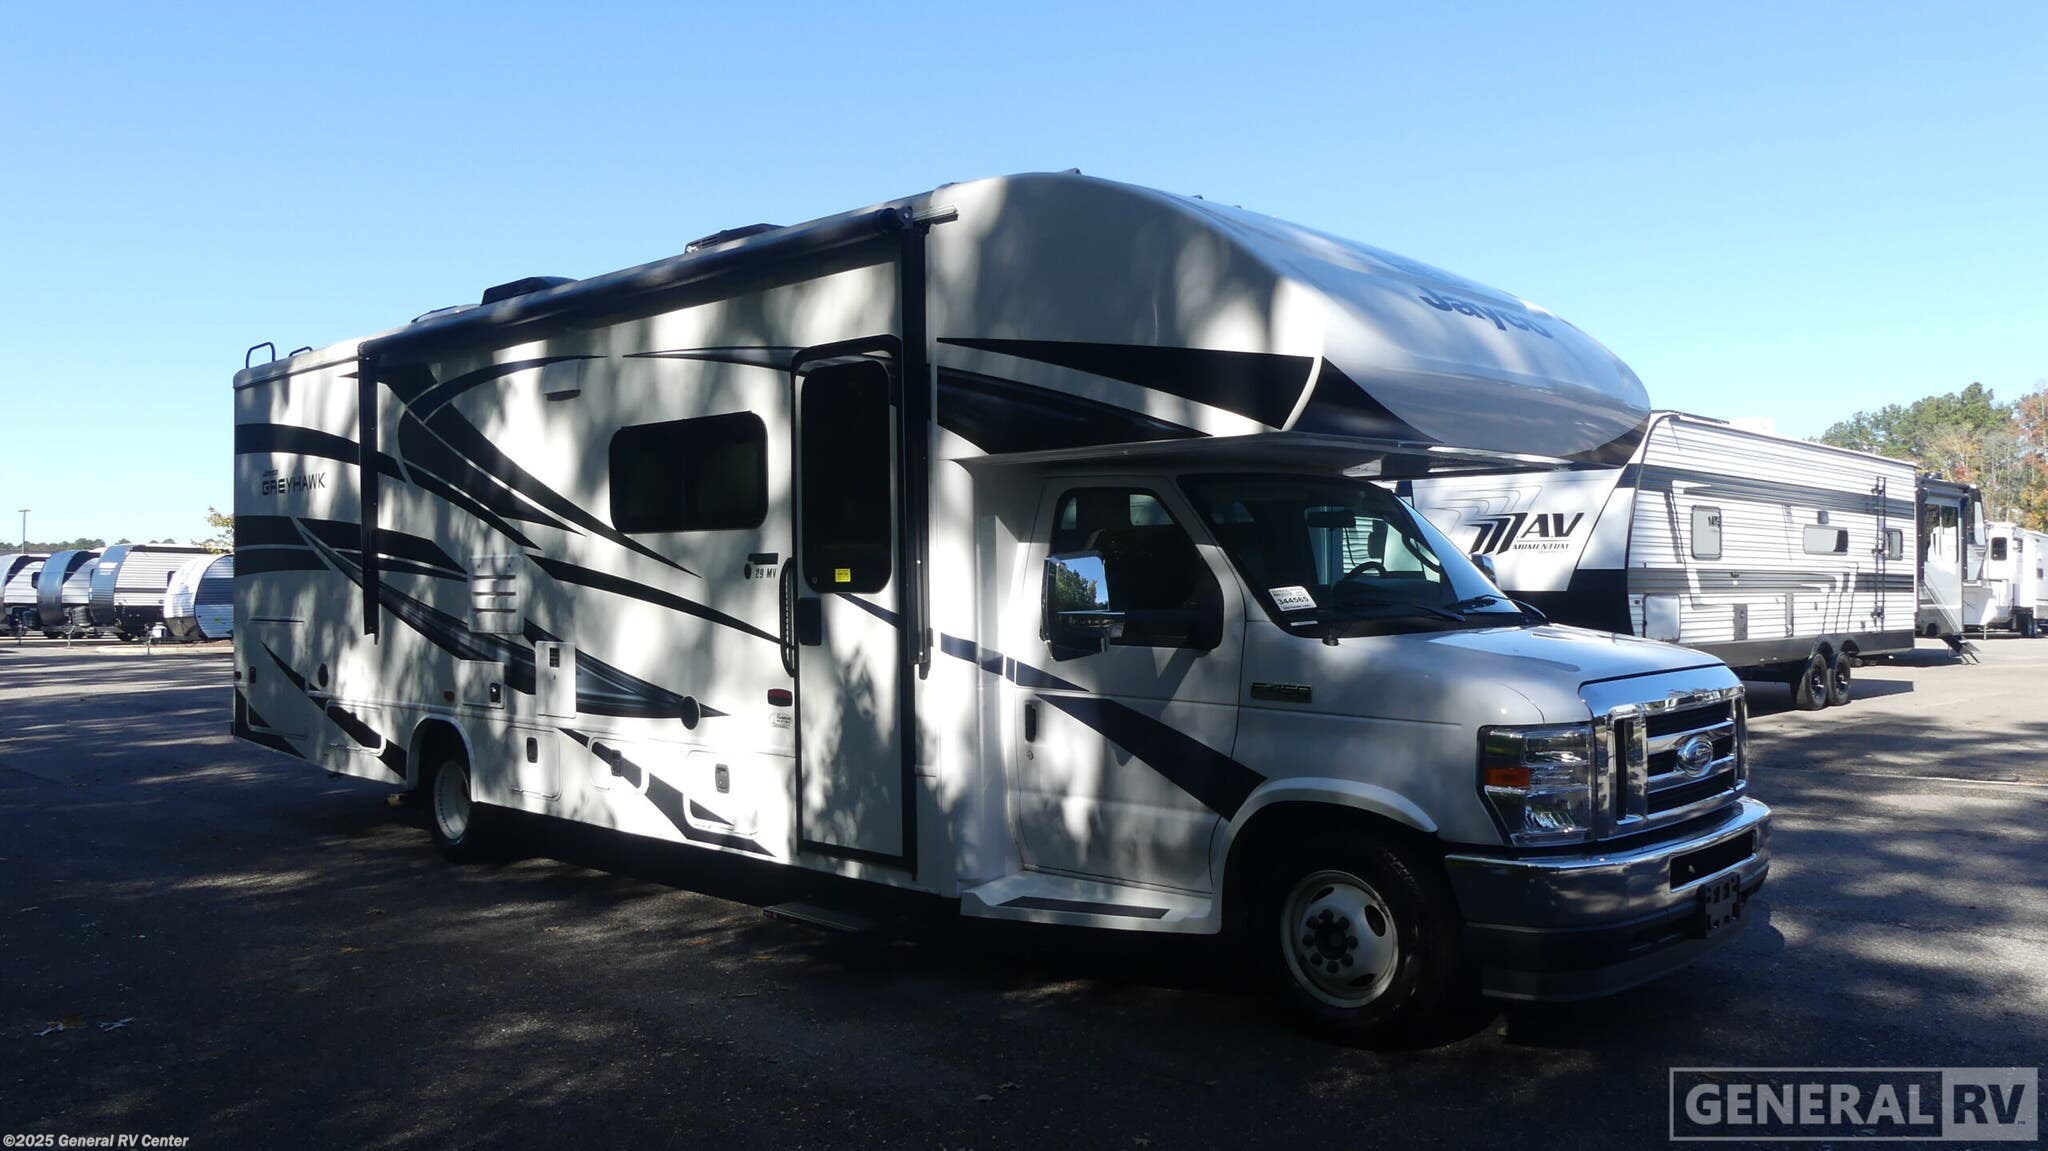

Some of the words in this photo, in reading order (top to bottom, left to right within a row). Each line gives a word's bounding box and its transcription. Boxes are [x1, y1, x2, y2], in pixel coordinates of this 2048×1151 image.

[1415, 283, 1553, 339] Jayco
[262, 472, 326, 496] GREYHAWK
[1512, 542, 1570, 551] MOMENTUM
[766, 567, 777, 578] MV
